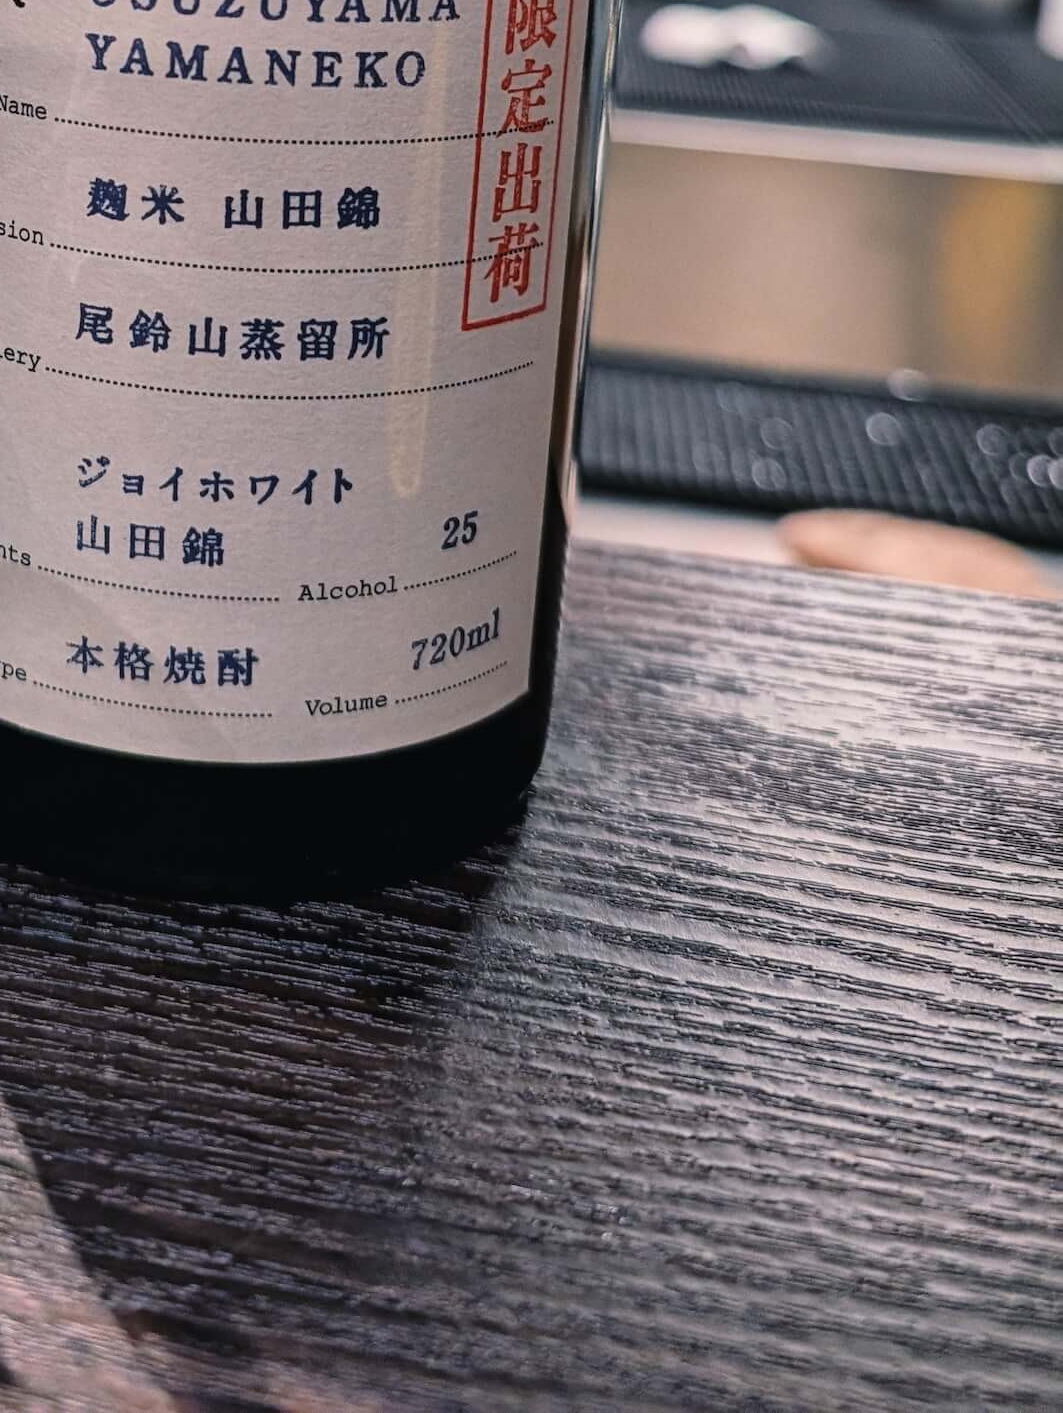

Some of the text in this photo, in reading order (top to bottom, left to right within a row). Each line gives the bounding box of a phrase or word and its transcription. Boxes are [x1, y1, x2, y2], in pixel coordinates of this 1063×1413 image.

[85, 33, 428, 89] YAMANEKO
[224, 186, 382, 231] 山田錦
[75, 302, 392, 363] 尾鈴山蒸留所
[76, 454, 354, 506] ジョイホワイト
[75, 516, 227, 570] 山田錦
[441, 510, 479, 552] 25
[298, 576, 398, 603] Alcohol
[65, 636, 261, 687] 本格焼酎
[410, 606, 502, 671] 720ml
[304, 694, 389, 718] Volume
